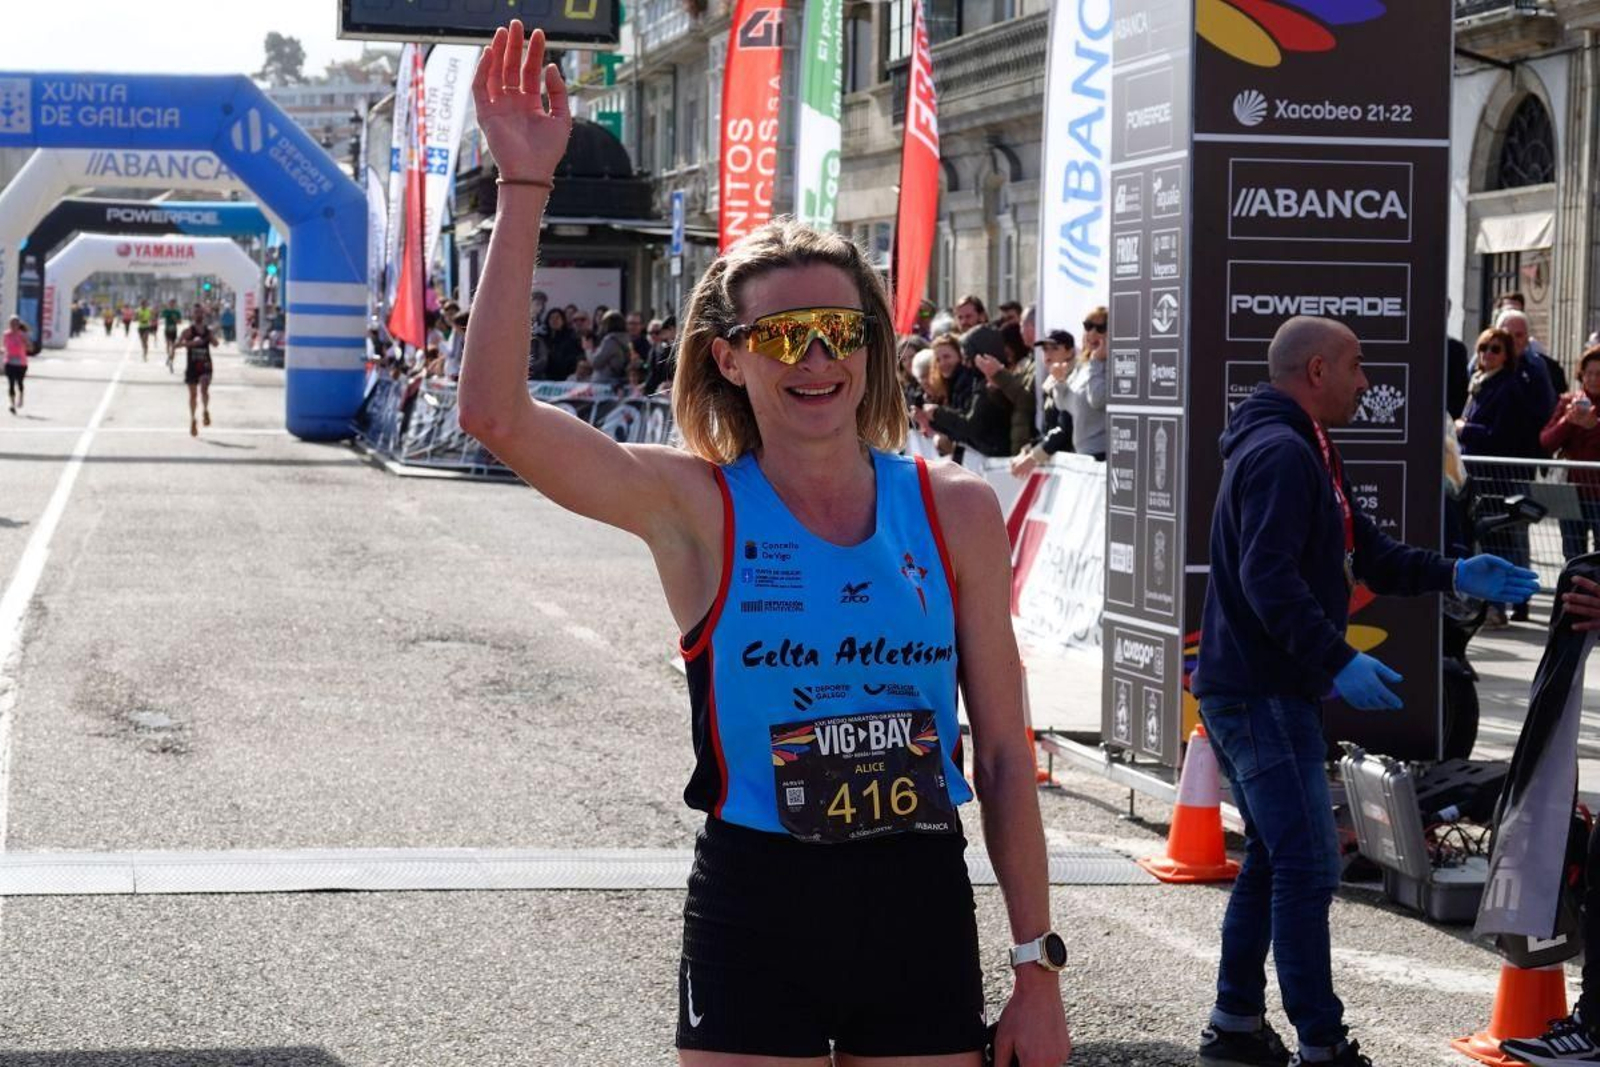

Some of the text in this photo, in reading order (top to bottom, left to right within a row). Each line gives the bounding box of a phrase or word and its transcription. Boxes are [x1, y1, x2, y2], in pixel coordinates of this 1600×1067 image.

[42, 82, 128, 103] XUNTA
[41, 105, 180, 128] DE GALICIA
[1274, 99, 1363, 120] Xacobeo
[725, 117, 754, 238] NITOS
[134, 243, 195, 258] YAMAHA
[1231, 295, 1404, 316] POWERADE
[762, 541, 800, 550] Concello
[841, 595, 870, 604] ZICO
[742, 638, 819, 667] Celta
[854, 762, 886, 774] ALICE
[827, 777, 918, 824] 416
